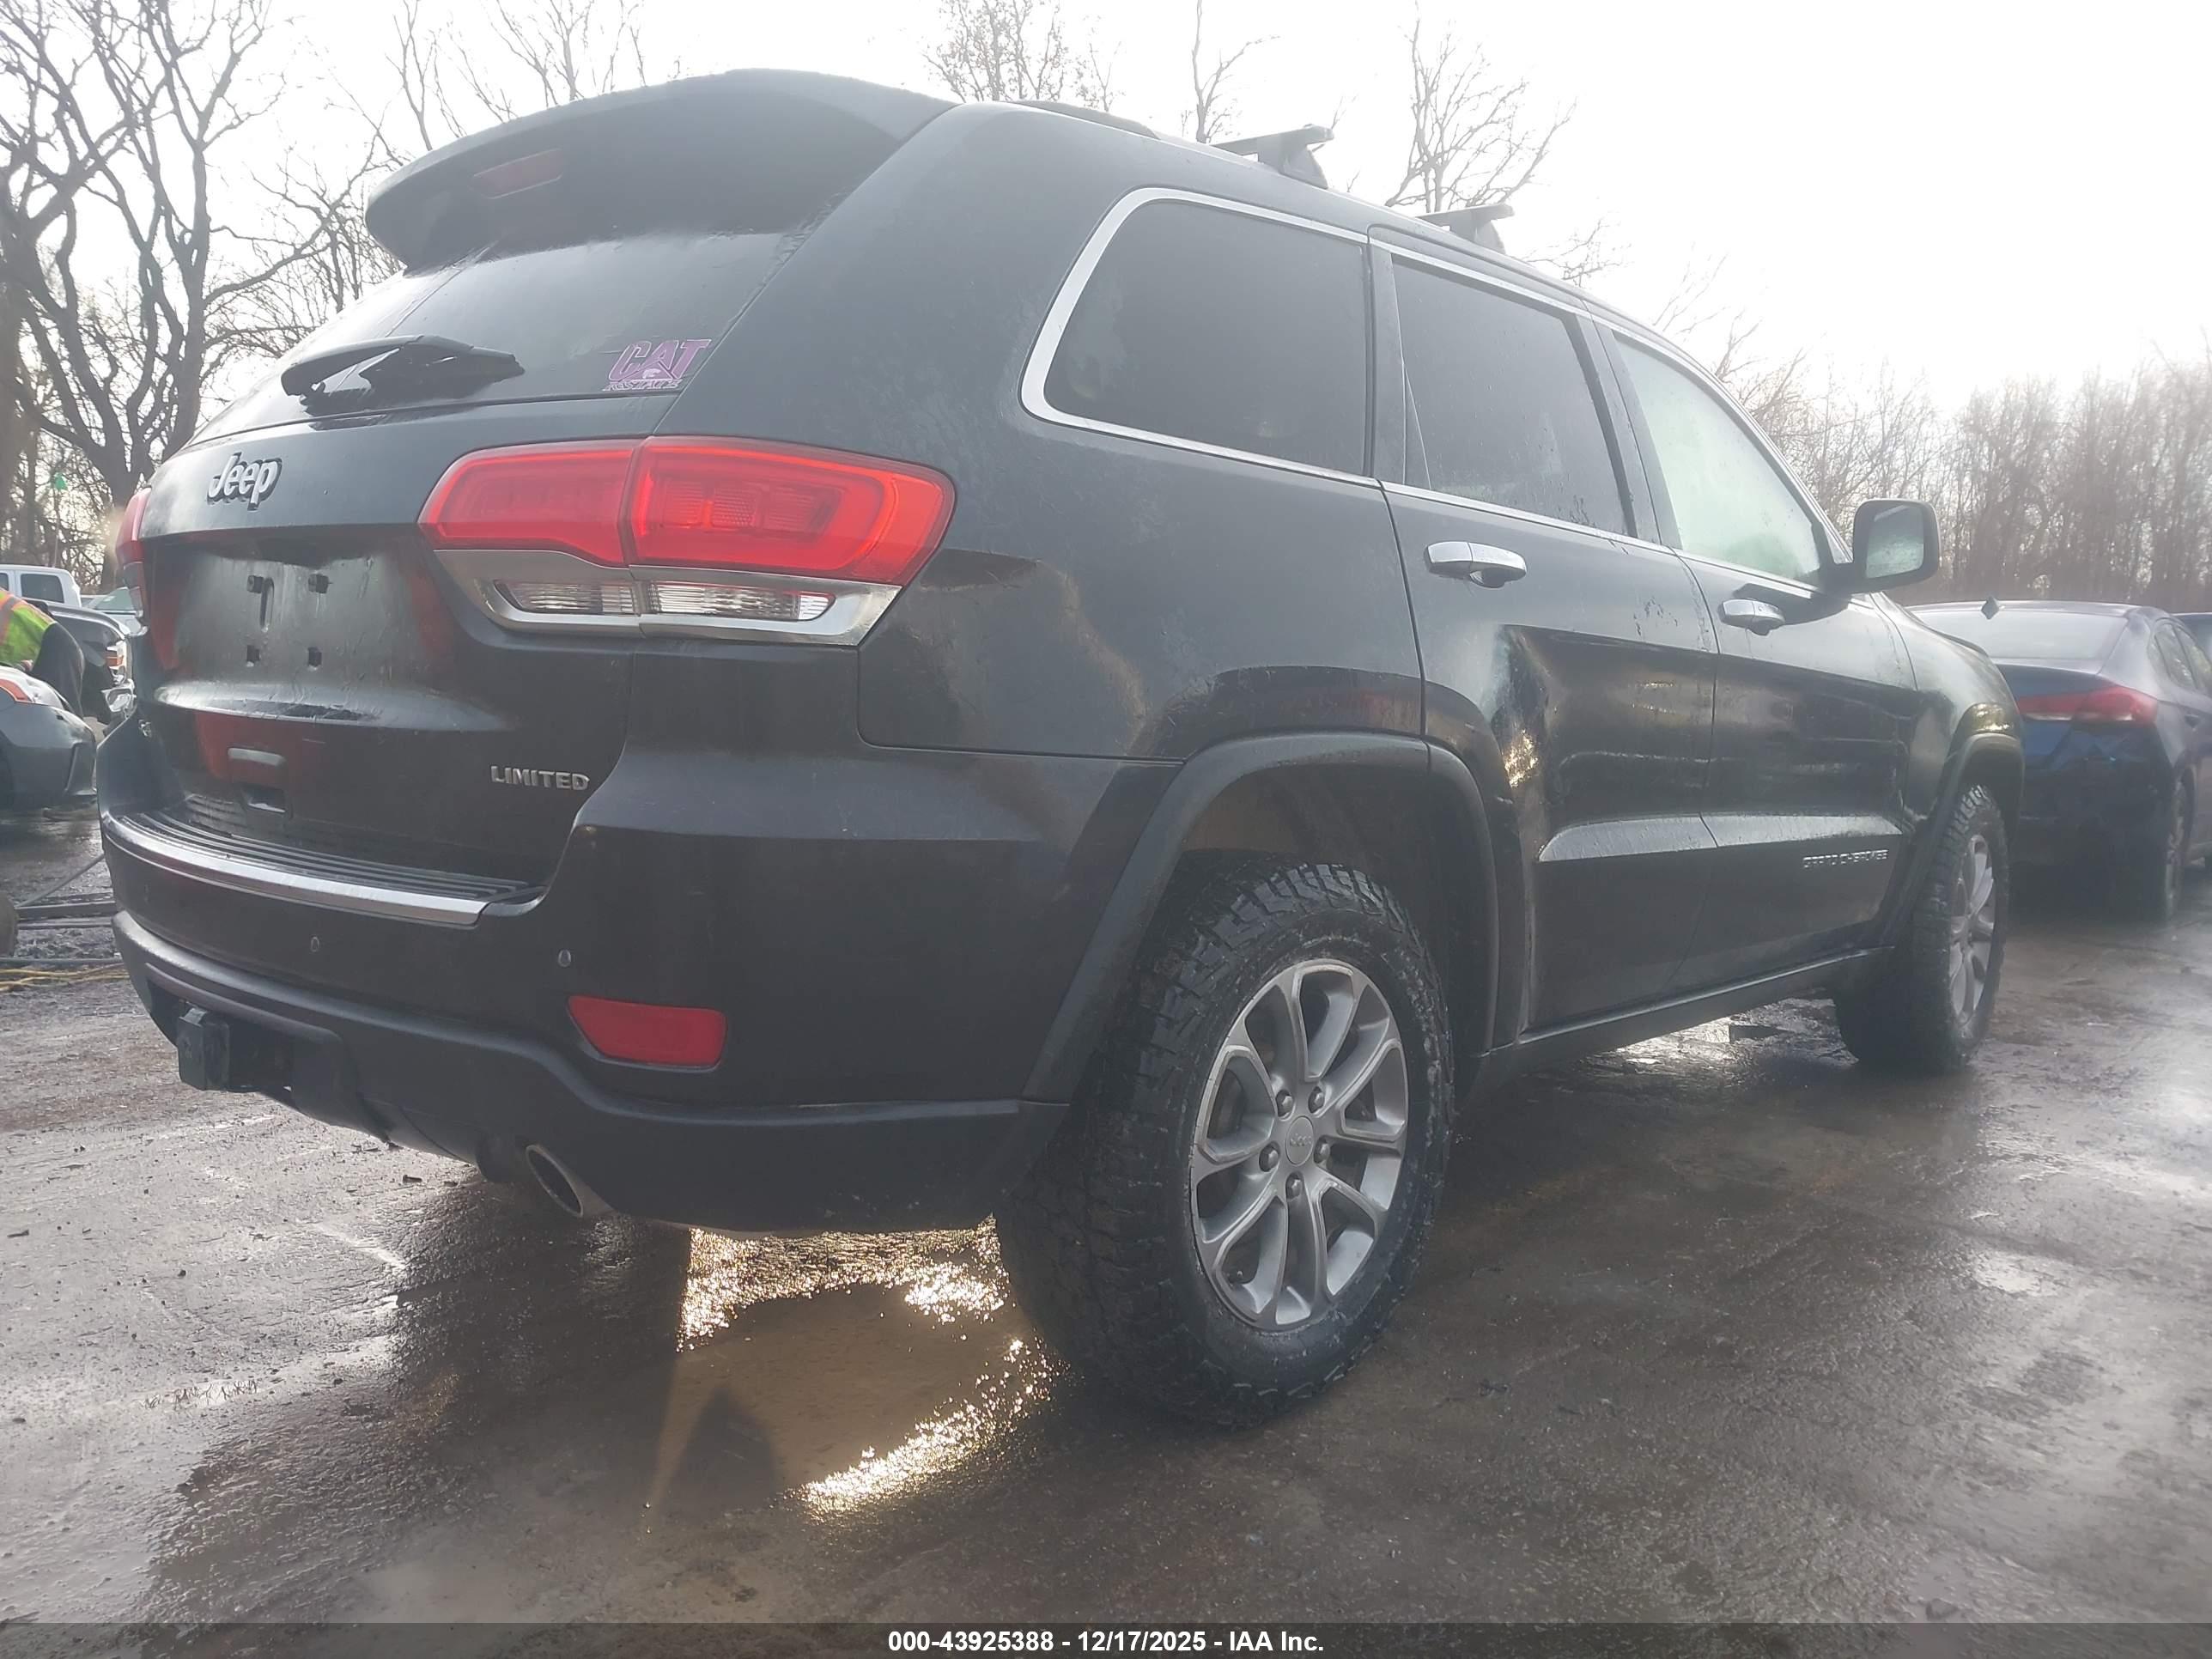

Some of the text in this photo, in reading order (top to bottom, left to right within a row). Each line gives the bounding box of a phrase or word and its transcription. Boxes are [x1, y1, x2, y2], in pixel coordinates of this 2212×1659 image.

[608, 338, 712, 381] CAT
[207, 452, 283, 511] Jeep
[490, 765, 590, 790] LIMITED
